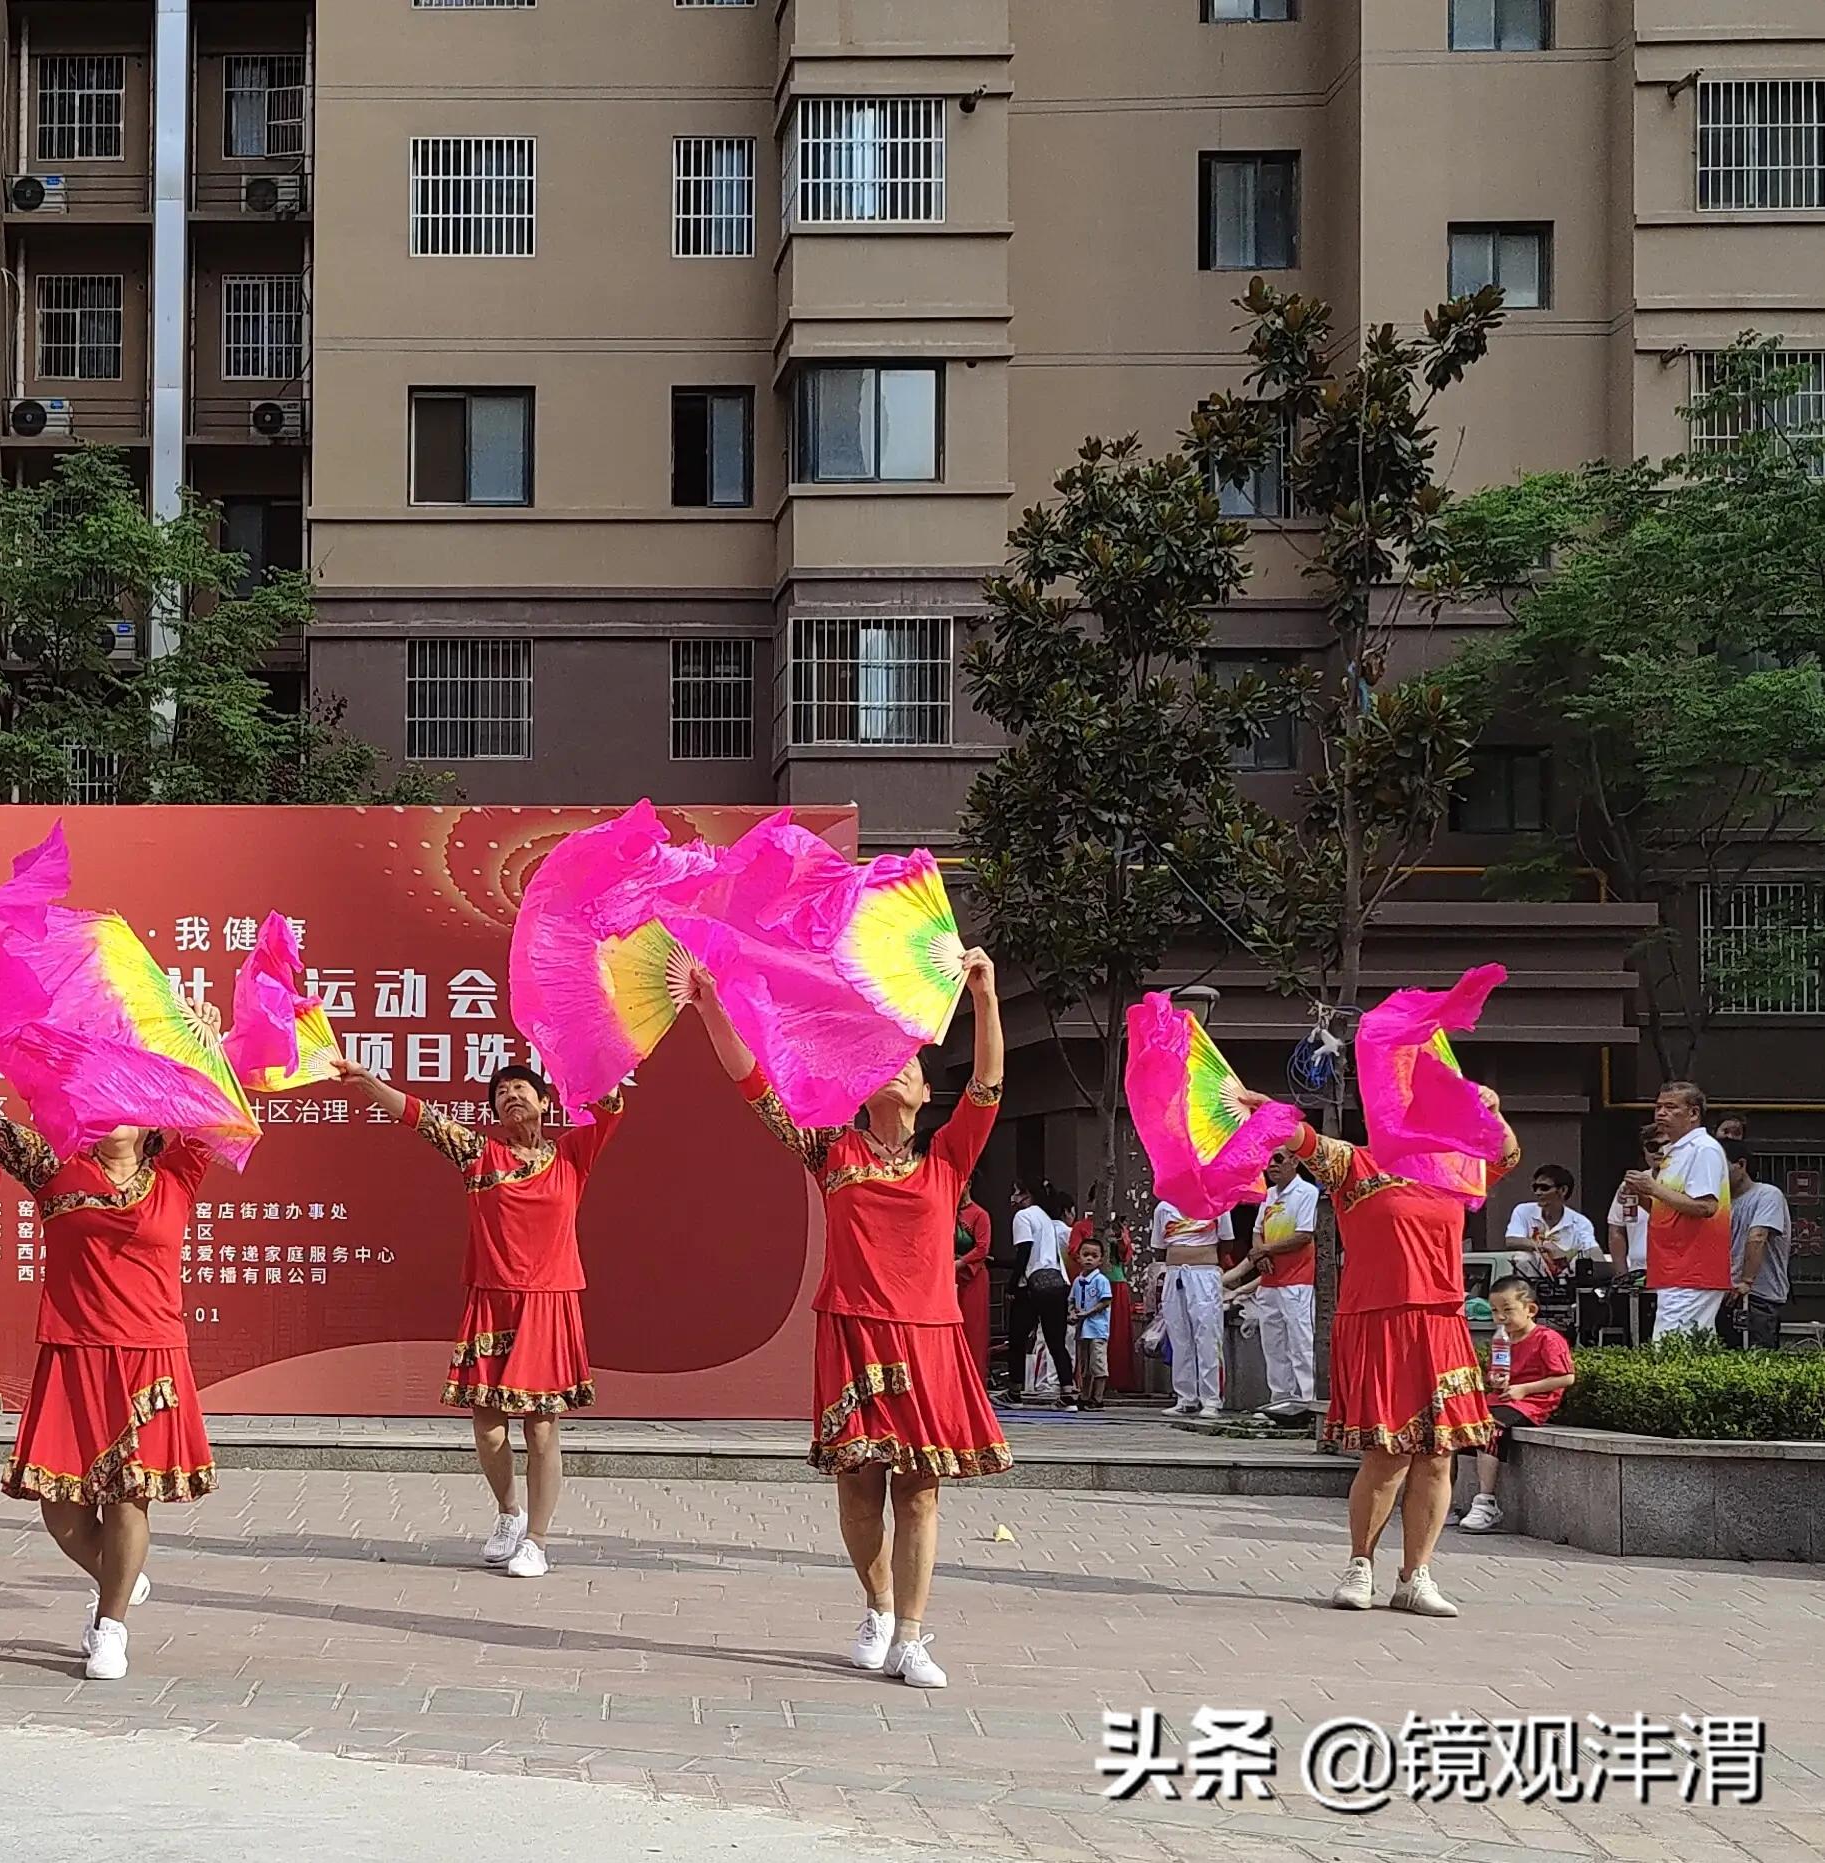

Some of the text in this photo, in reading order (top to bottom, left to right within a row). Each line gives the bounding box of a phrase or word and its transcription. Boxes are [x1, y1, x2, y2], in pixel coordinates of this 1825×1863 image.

[195, 1202, 348, 1220] 窑店街道办事处
